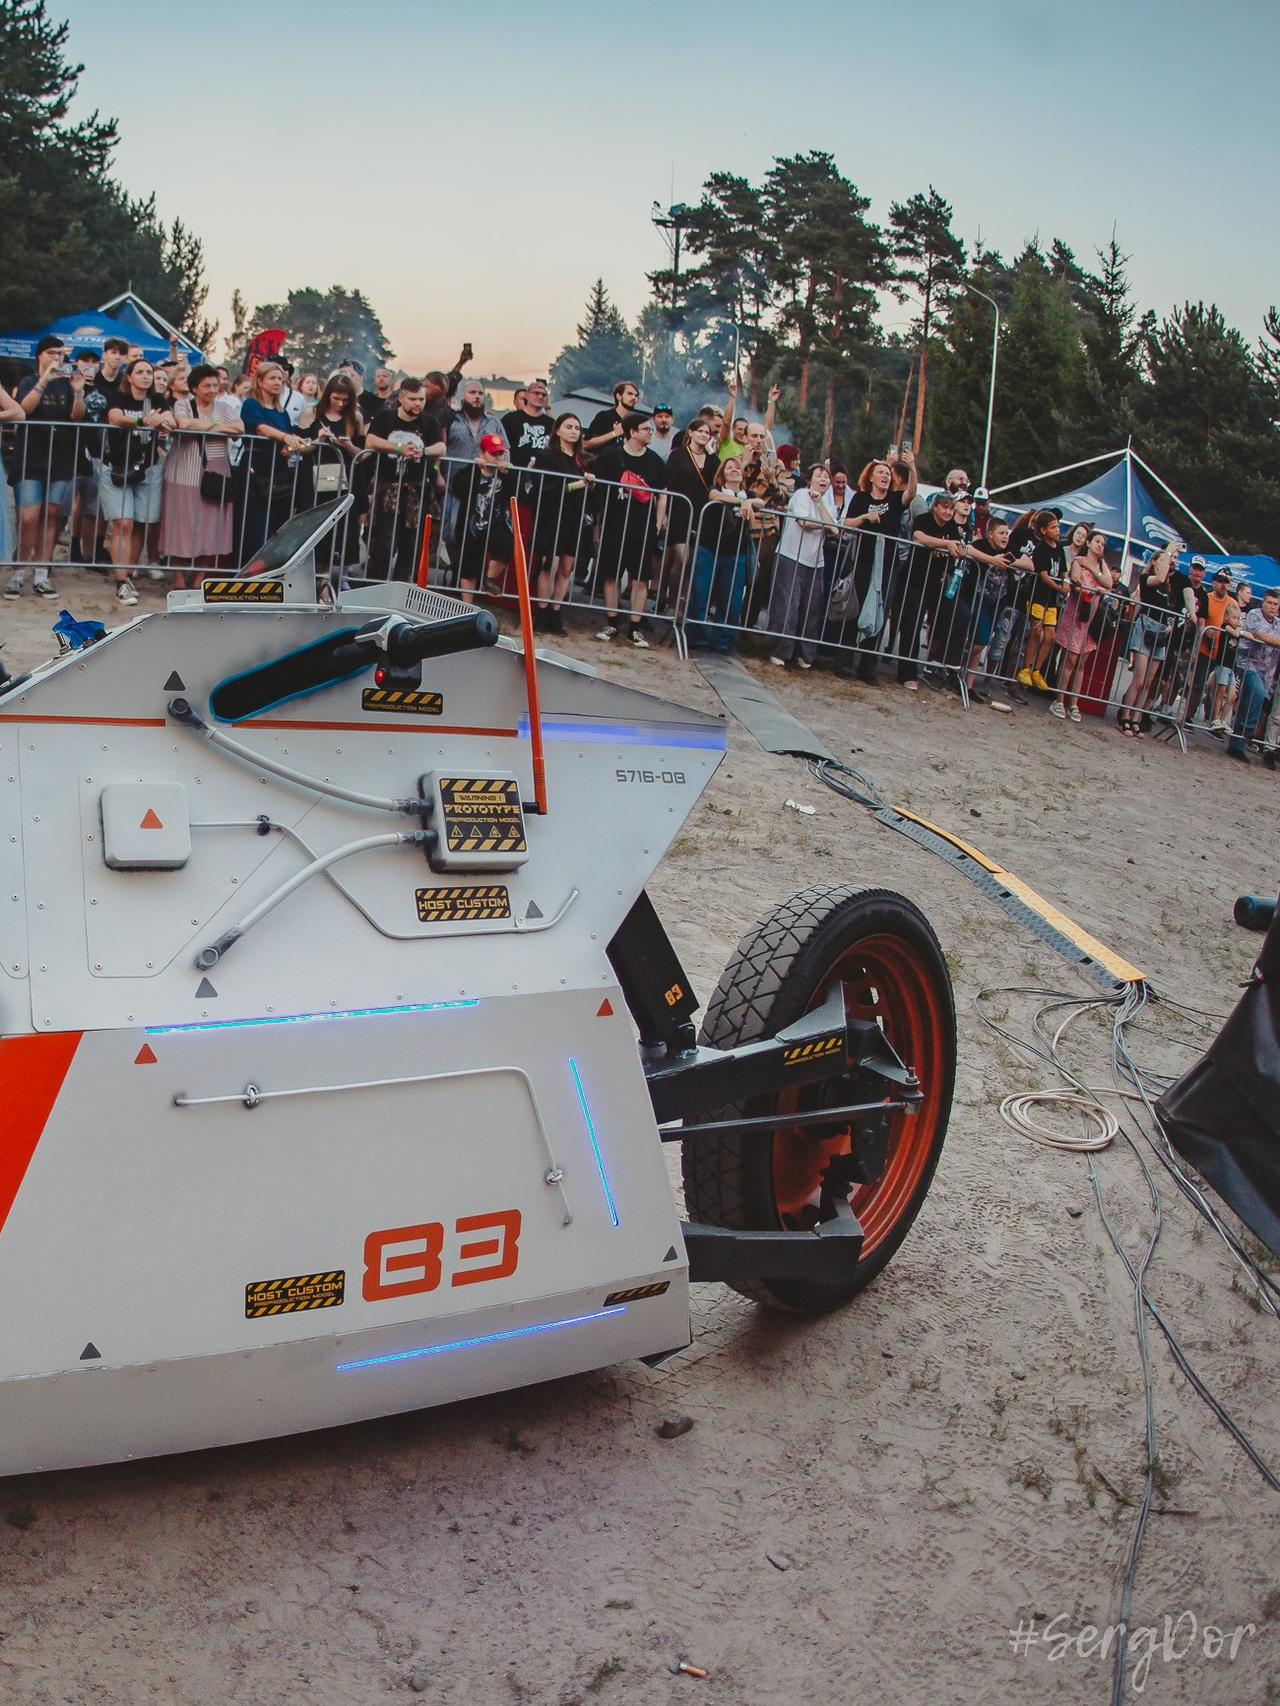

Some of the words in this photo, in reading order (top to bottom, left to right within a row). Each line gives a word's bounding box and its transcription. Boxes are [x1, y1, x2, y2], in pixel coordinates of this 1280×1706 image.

[364, 702, 417, 711] PREPRODUCTION
[444, 804, 521, 813] PROTOTYPE
[418, 900, 452, 910] HOST
[456, 898, 508, 909] CUSTOM
[664, 984, 684, 1006] 83
[362, 1209, 522, 1302] 83
[248, 1290, 283, 1303] HOST
[288, 1281, 342, 1296] CUSTOM
[254, 1295, 311, 1307] PREPRODUCTION
[312, 1291, 335, 1300] MODEL
